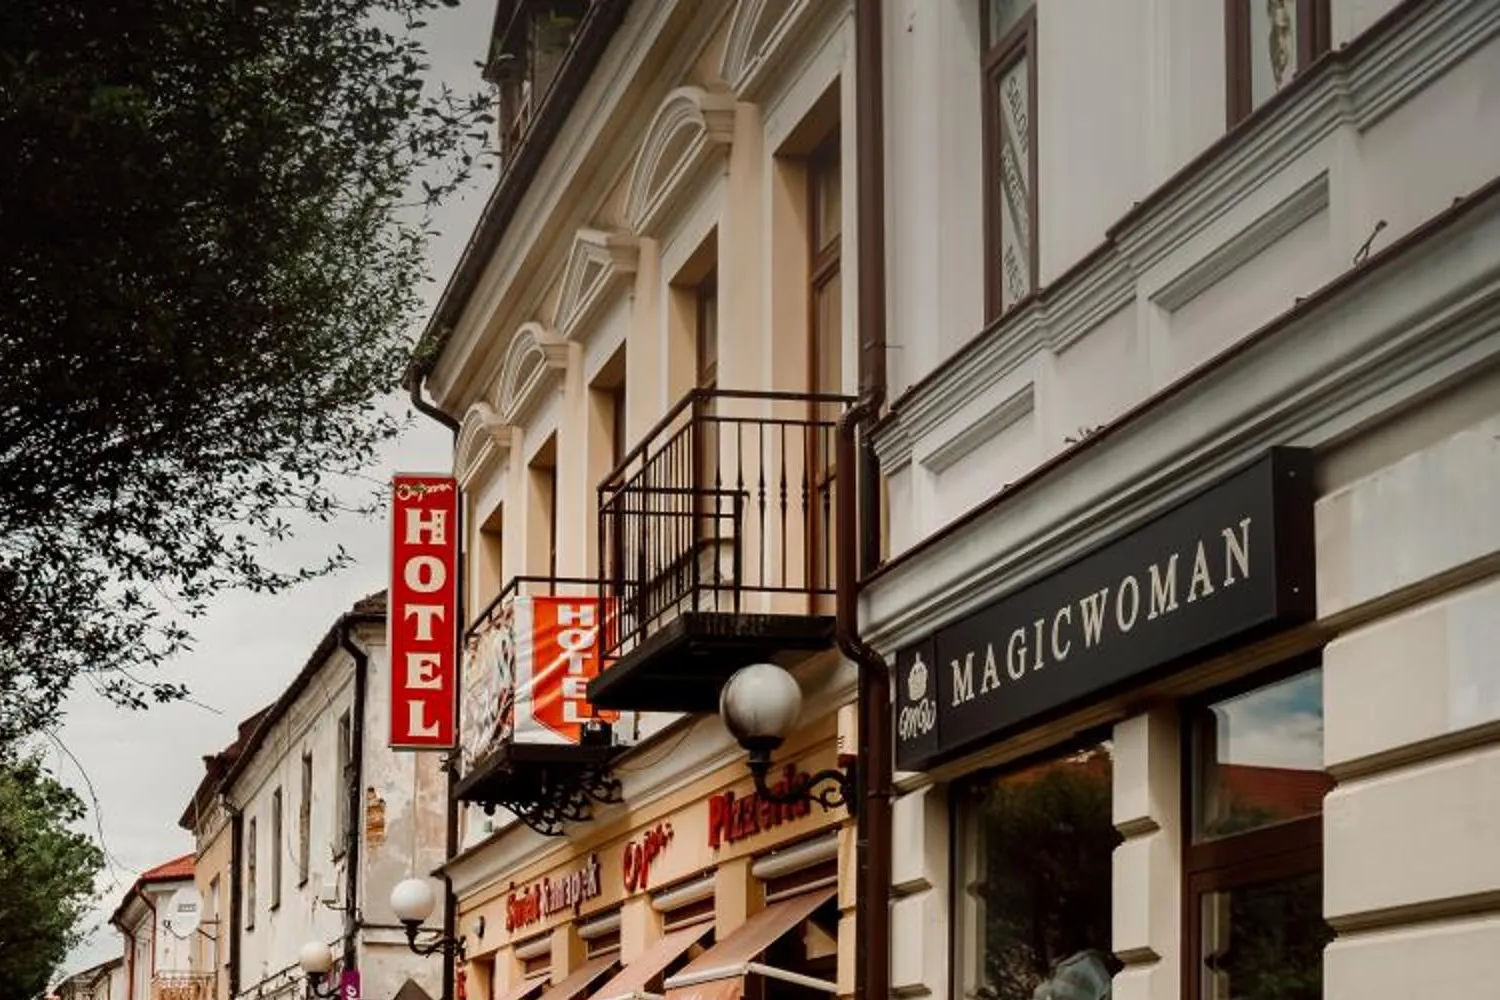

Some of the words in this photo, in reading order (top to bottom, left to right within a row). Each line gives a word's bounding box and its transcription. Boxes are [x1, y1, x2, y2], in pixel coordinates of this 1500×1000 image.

[404, 508, 447, 737] HOTEL
[557, 604, 595, 723] HOTEL
[950, 518, 1251, 707] MAGICWOMAN
